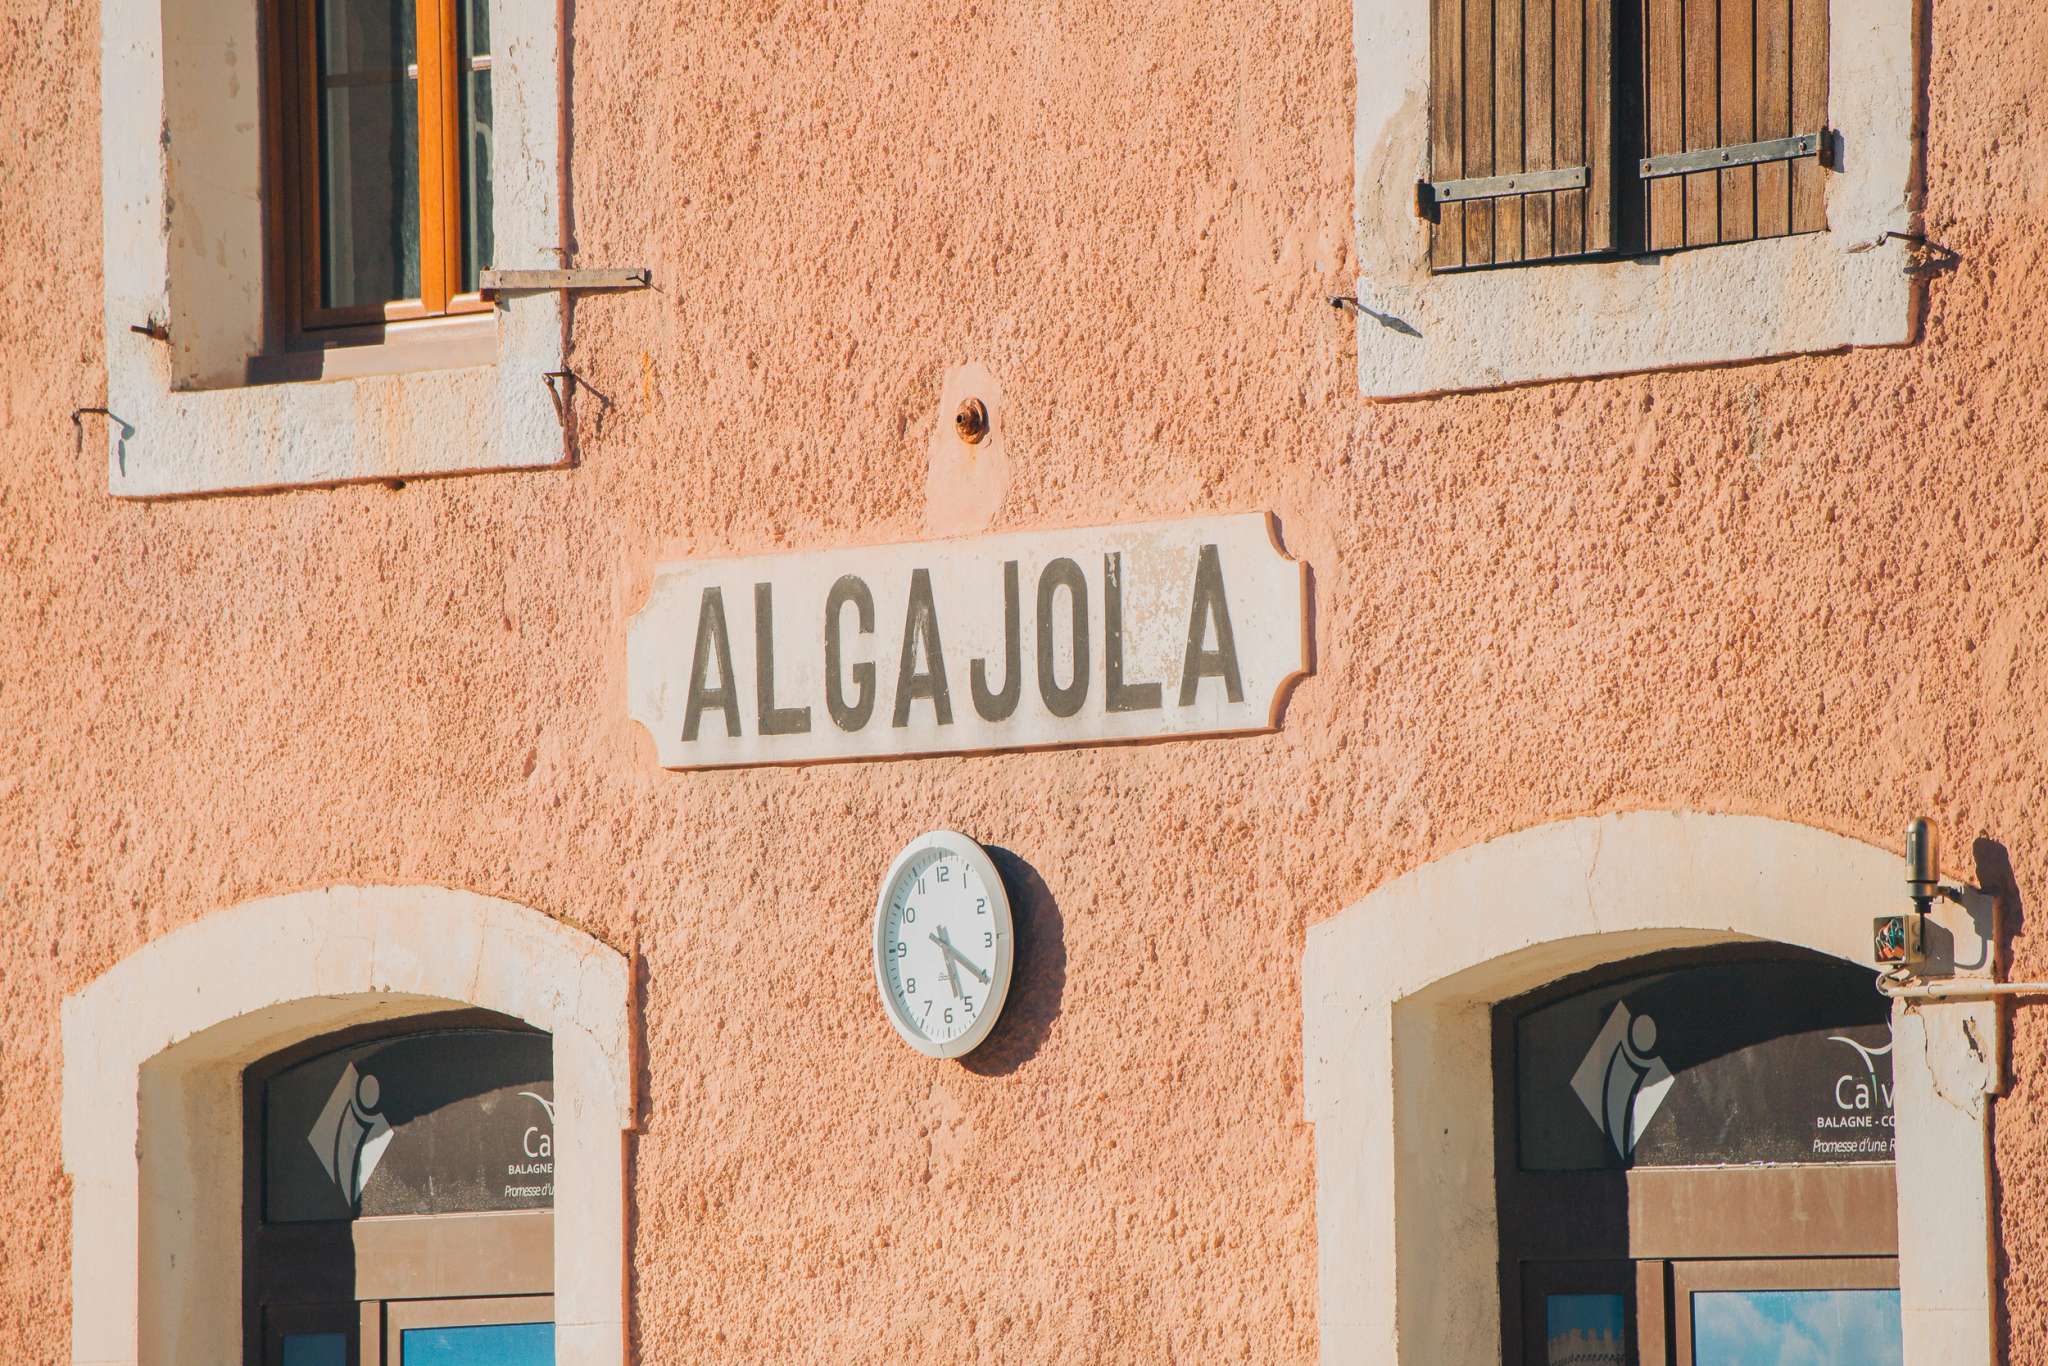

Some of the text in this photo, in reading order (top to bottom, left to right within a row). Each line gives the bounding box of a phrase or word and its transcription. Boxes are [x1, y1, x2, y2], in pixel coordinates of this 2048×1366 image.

[682, 544, 1244, 742] ALGAJOLA
[936, 866, 949, 883] 12
[962, 873, 967, 889] 1
[917, 879, 926, 895] 11
[976, 898, 986, 914] 2
[902, 908, 916, 924] 10
[984, 932, 993, 948] 3
[898, 943, 907, 958] 9
[907, 978, 916, 994] 8
[924, 1000, 933, 1017] 7
[964, 996, 973, 1012] 5
[944, 1008, 953, 1024] 6
[1817, 1116, 1872, 1128] BALAGNE
[523, 1126, 552, 1158] Ca
[1813, 1139, 1858, 1153] Promesse
[1859, 1137, 1887, 1152] d'une
[508, 1163, 553, 1175] BALAGNE
[504, 1185, 541, 1198] Promesse
